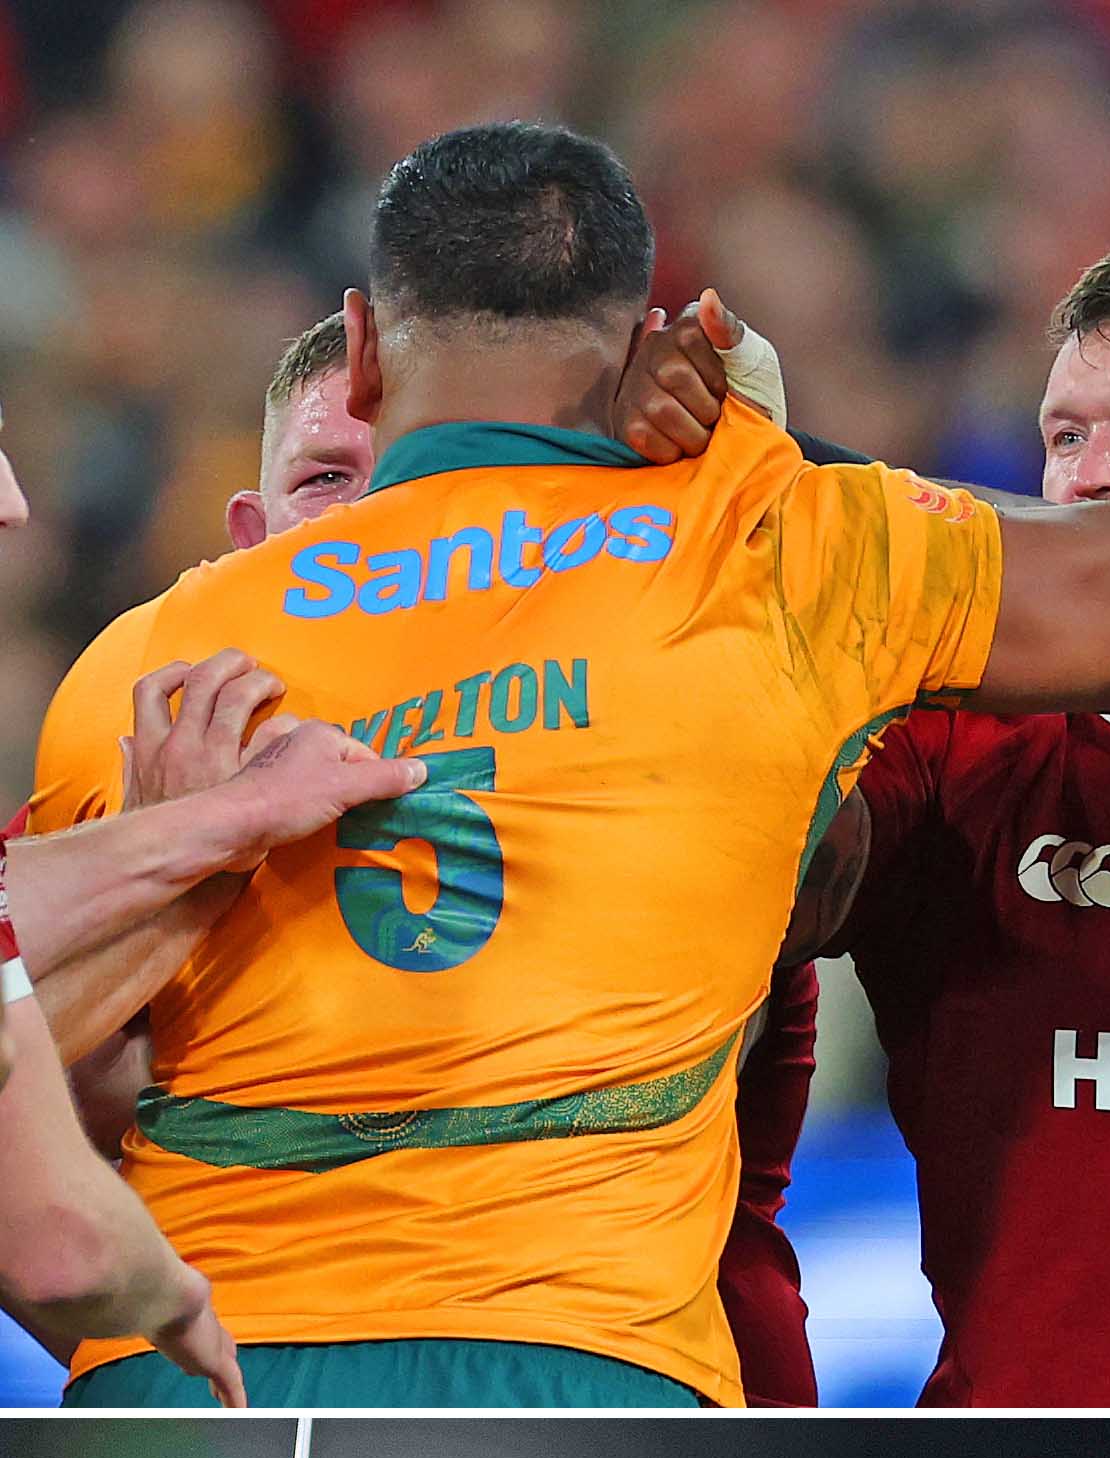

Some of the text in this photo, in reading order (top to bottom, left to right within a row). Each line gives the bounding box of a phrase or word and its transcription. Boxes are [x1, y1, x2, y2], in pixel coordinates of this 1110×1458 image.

[283, 505, 674, 619] Santos
[334, 658, 590, 761] KELTON
[334, 746, 505, 972] 5
